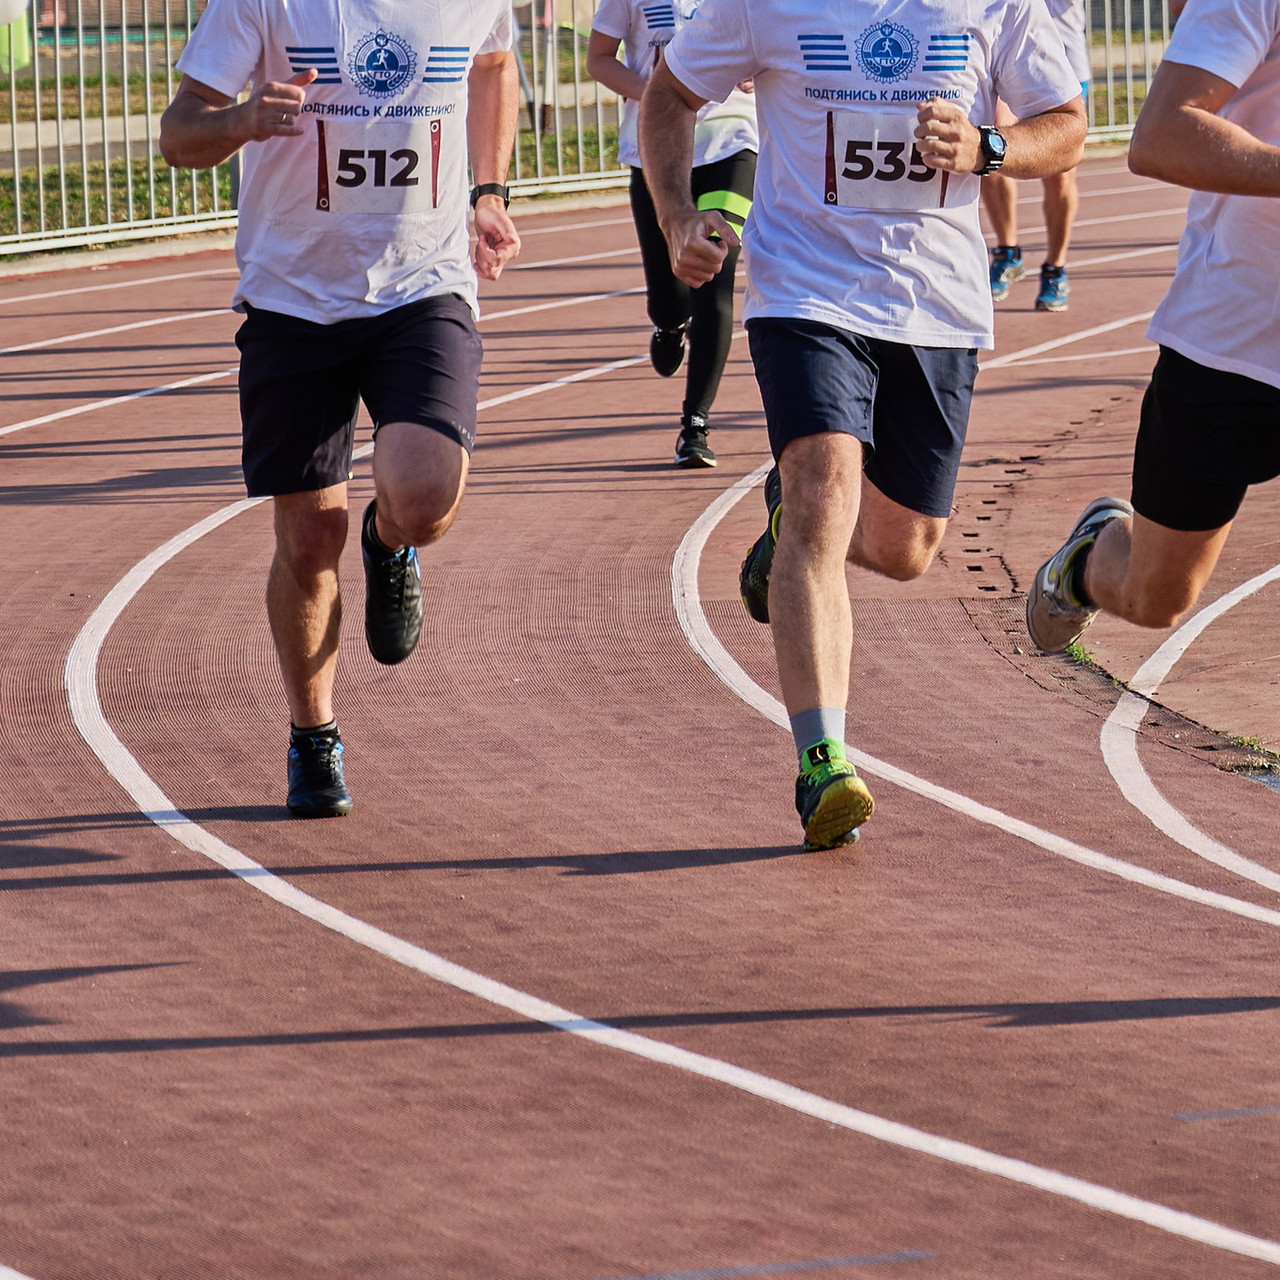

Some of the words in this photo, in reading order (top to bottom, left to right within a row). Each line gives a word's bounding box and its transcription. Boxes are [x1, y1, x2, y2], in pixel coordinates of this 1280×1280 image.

[879, 58, 896, 66] ГТО
[373, 71, 391, 79] ГТО
[805, 87, 877, 101] ПОДТЯНИСЬ
[880, 90, 888, 101] К
[374, 105, 382, 117] К
[384, 103, 456, 118] ДВИЖЕНИЮ!
[335, 148, 419, 188] 512
[841, 140, 937, 183] 535
